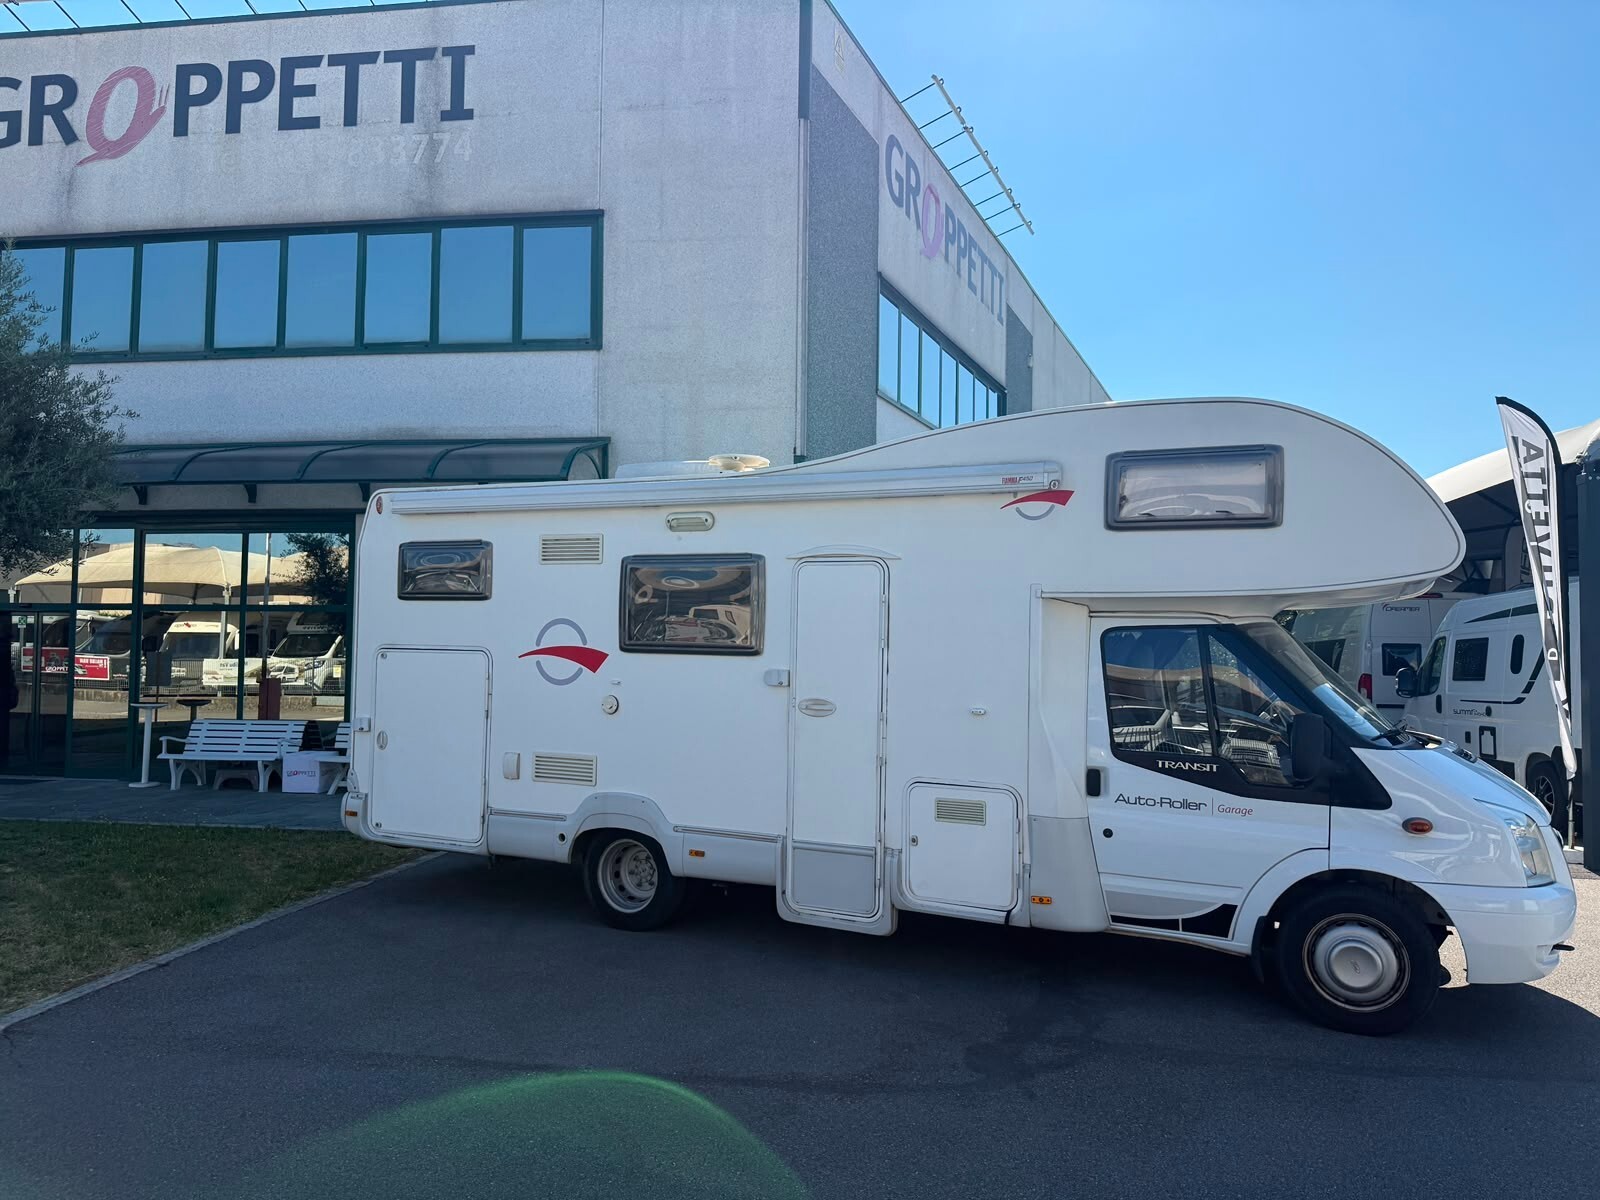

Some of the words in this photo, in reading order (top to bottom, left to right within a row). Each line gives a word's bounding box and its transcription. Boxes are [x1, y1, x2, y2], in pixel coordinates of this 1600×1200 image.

[885, 134, 1005, 326] GROPPETTI
[1156, 760, 1219, 773] TRANSIT
[1114, 793, 1207, 811] Auto-Roller
[1217, 804, 1253, 817] Garage
